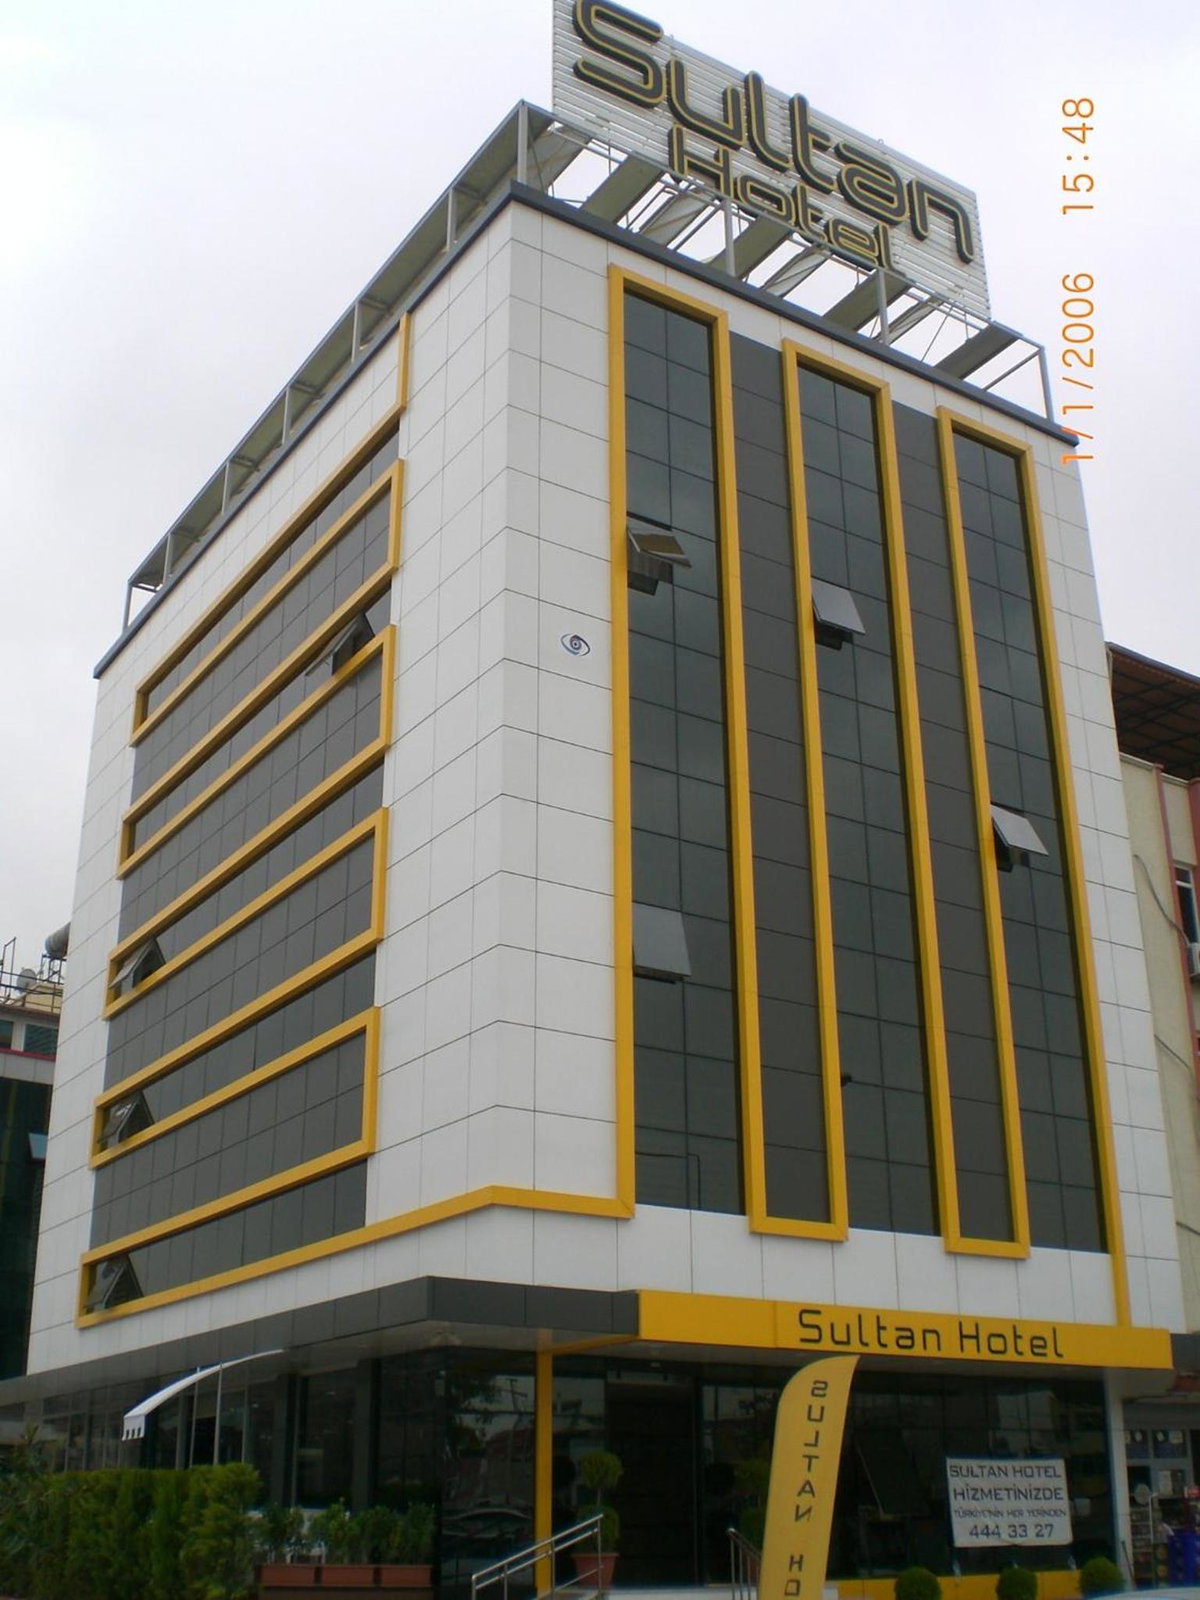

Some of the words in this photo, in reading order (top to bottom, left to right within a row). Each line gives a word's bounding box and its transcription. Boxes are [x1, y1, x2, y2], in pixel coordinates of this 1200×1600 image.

[573, 0, 975, 264] Sultan
[668, 123, 902, 272] Hotel
[799, 1309, 941, 1352] Sultan
[959, 1320, 1064, 1358] Hotel
[949, 1465, 1009, 1478] SULTAN
[1013, 1465, 1062, 1479] HOTEL
[953, 1483, 1064, 1501] HİZMETİNİZDE
[969, 1524, 1001, 1539] 444
[1008, 1524, 1028, 1538] 33
[1034, 1523, 1054, 1538] 27
